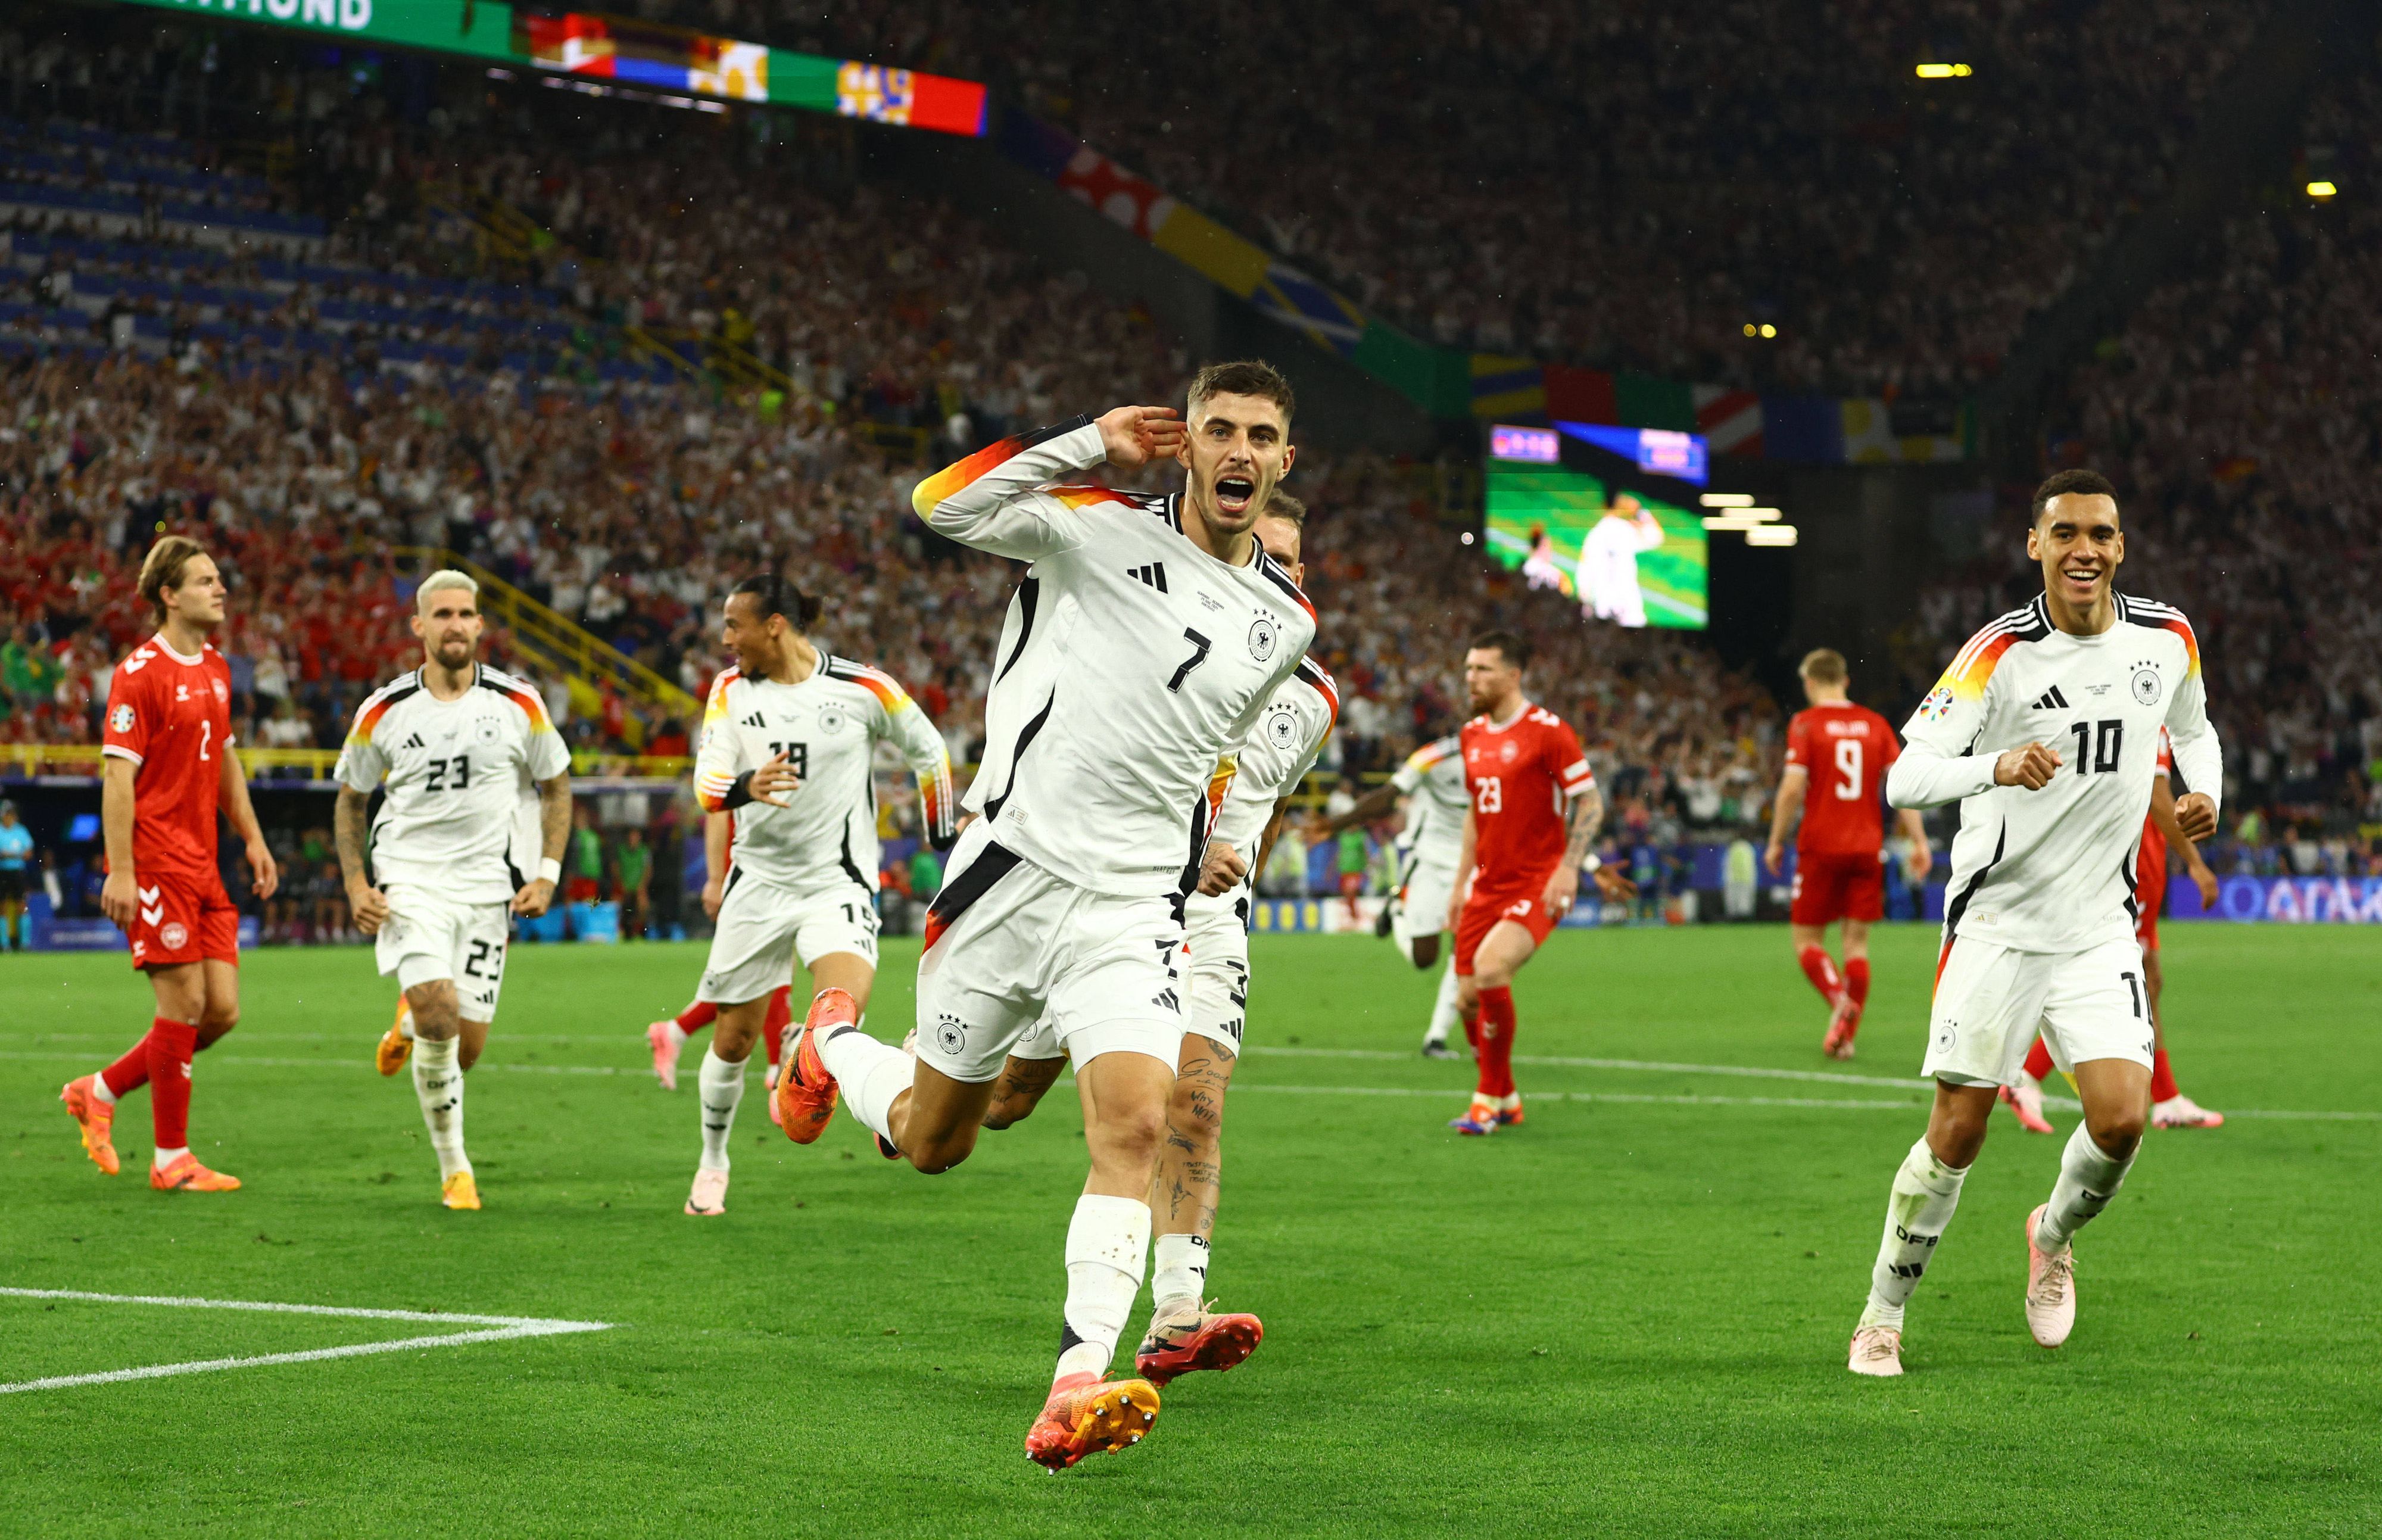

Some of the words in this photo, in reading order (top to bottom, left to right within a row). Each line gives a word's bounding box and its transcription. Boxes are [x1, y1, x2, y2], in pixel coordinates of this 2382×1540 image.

[1167, 626, 1212, 693] 7
[199, 719, 211, 761] 2
[2071, 719, 2124, 775] 10
[426, 755, 468, 791] 23
[1835, 738, 1863, 800] 9
[1475, 776, 1502, 814] 23
[2121, 972, 2153, 1028] 1
[1897, 1224, 1938, 1247] DFB
